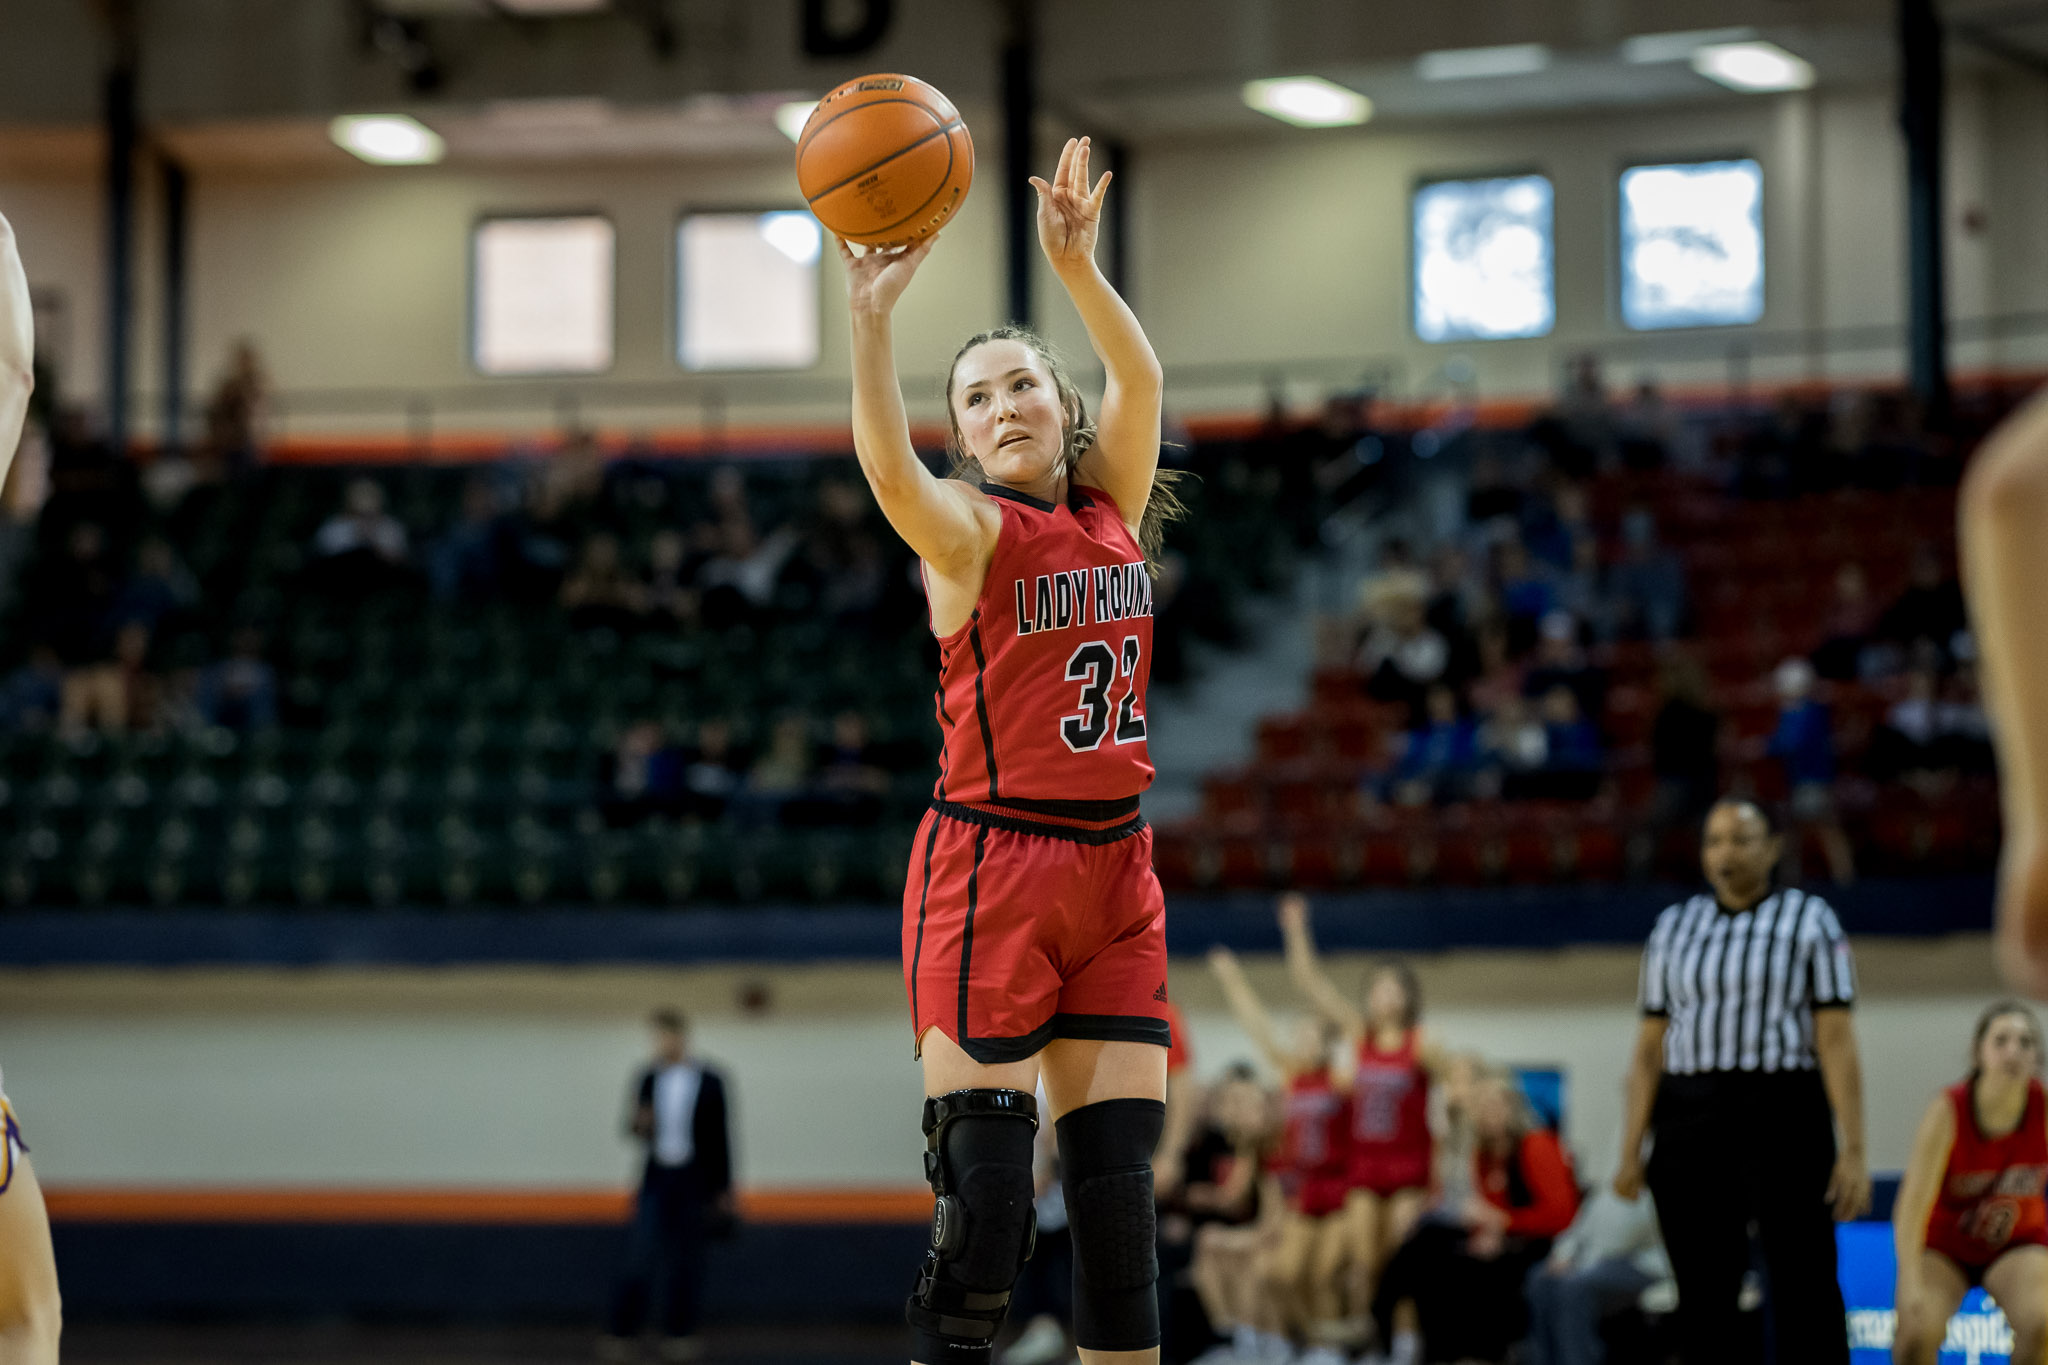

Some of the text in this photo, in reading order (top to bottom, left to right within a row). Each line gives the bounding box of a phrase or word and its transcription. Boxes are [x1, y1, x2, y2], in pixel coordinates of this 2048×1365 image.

[1015, 560, 1153, 636] LADY HOUND
[1059, 635, 1147, 754] 32
